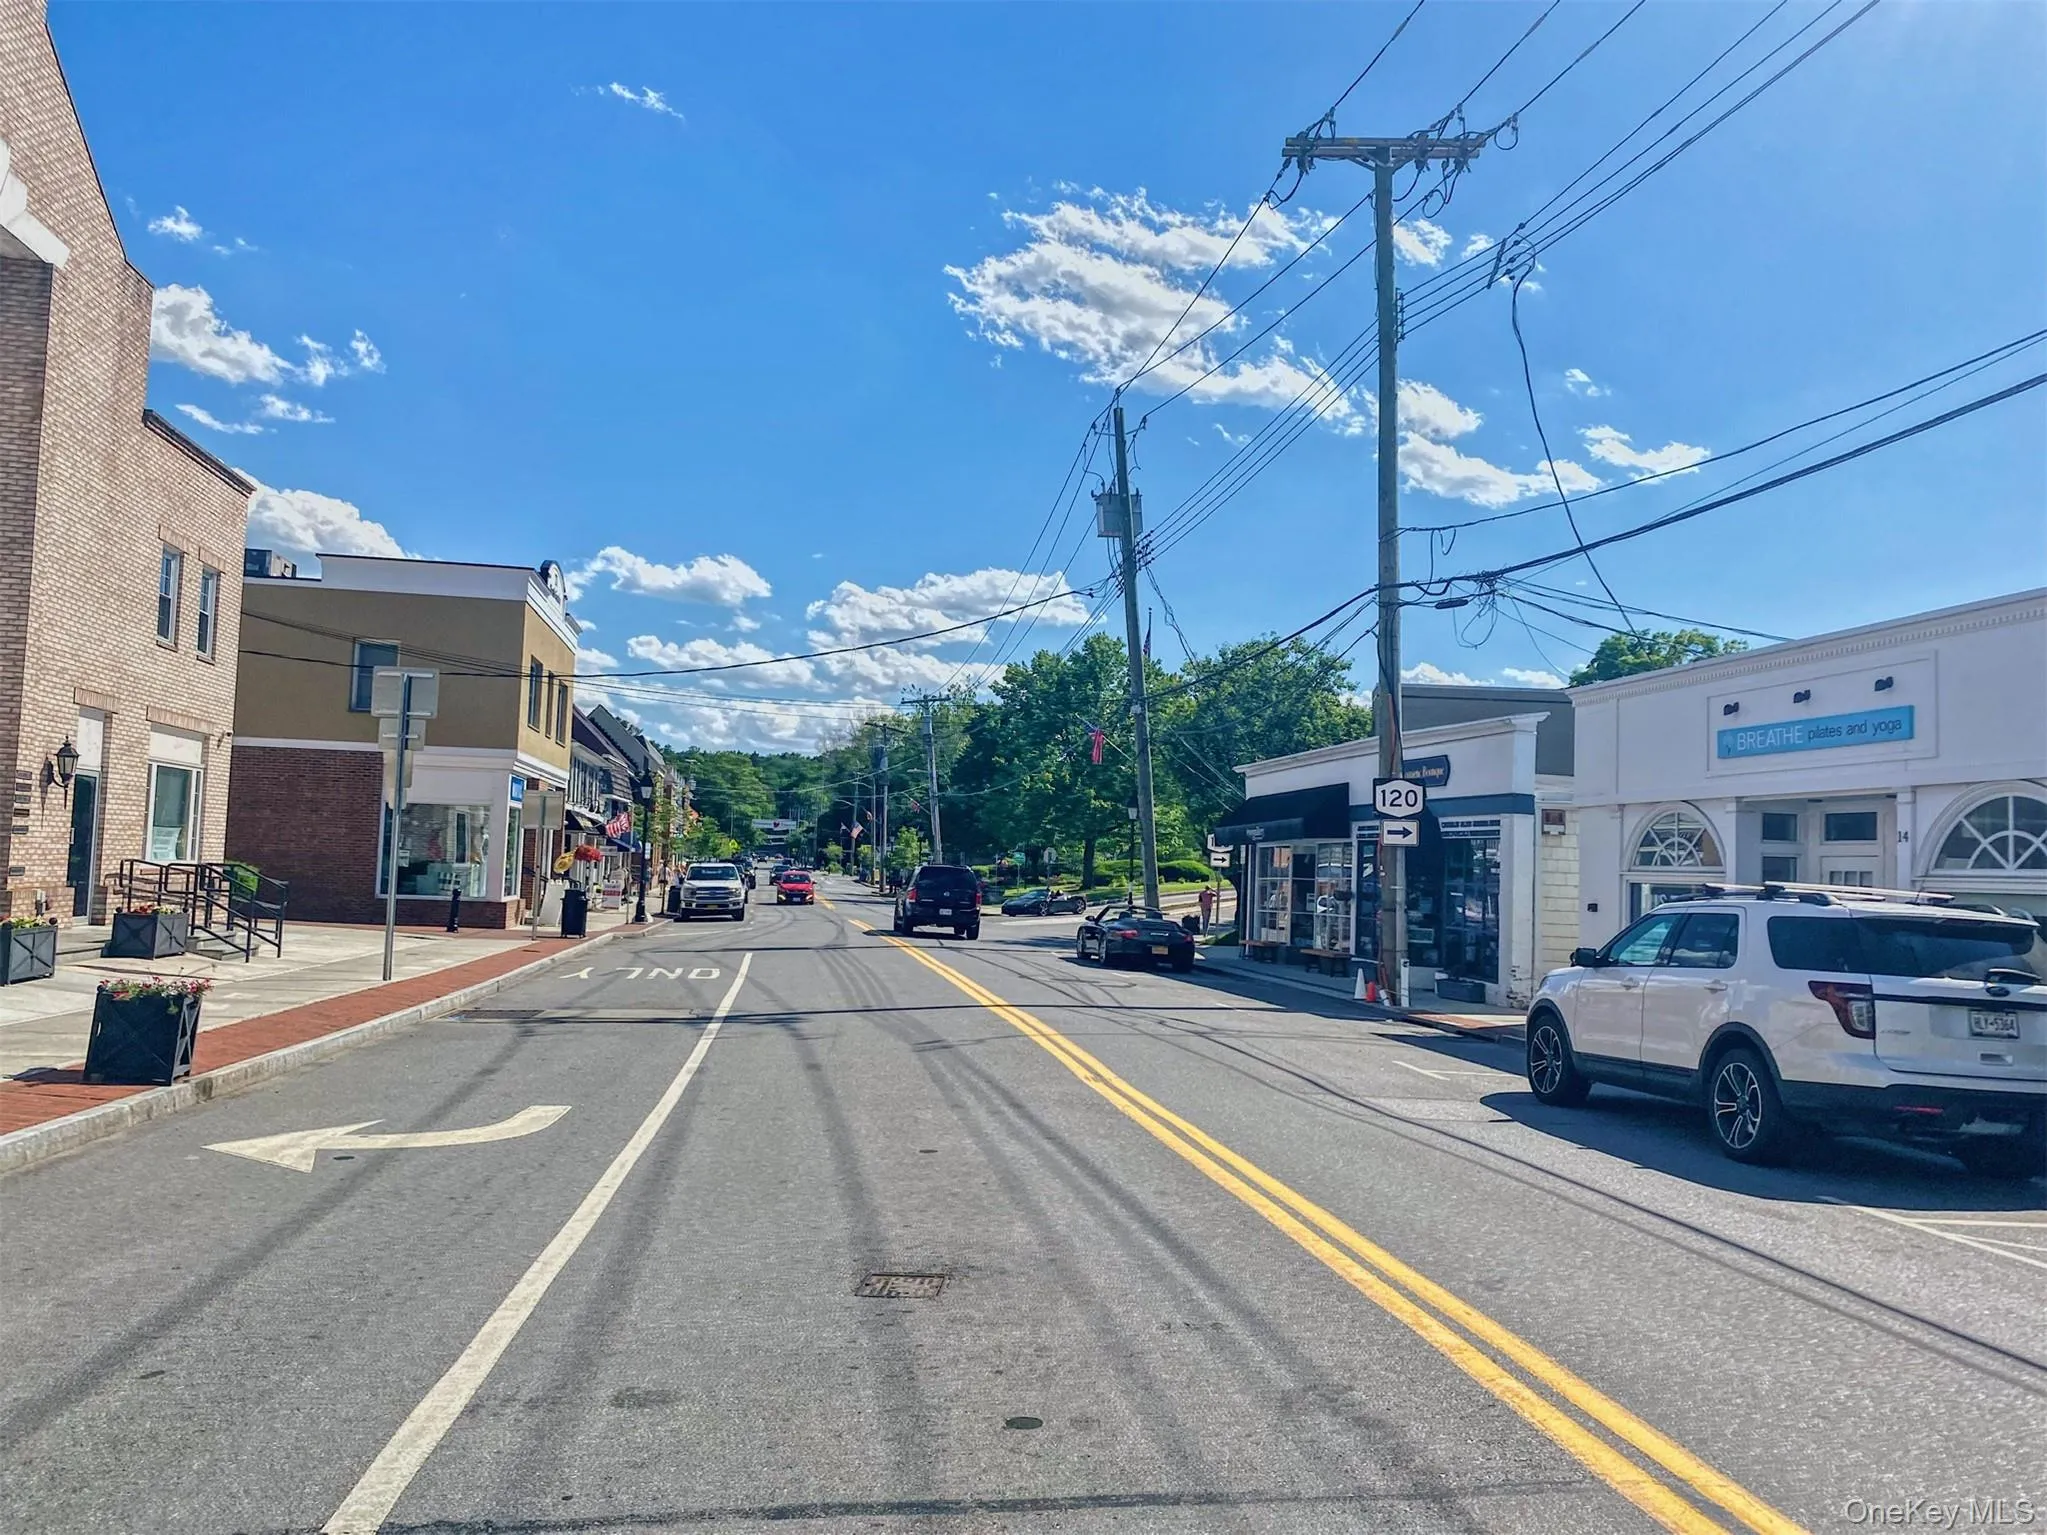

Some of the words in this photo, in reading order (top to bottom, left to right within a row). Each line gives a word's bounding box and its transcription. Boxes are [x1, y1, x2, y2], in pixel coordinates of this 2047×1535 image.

[1737, 725, 1804, 751] BREATHE
[1807, 725, 1842, 742] pilates
[1846, 719, 1868, 736] and
[1871, 719, 1903, 737] yoga
[1380, 789, 1418, 808] 120
[1898, 830, 1909, 843] 14
[559, 967, 721, 980] ONLY
